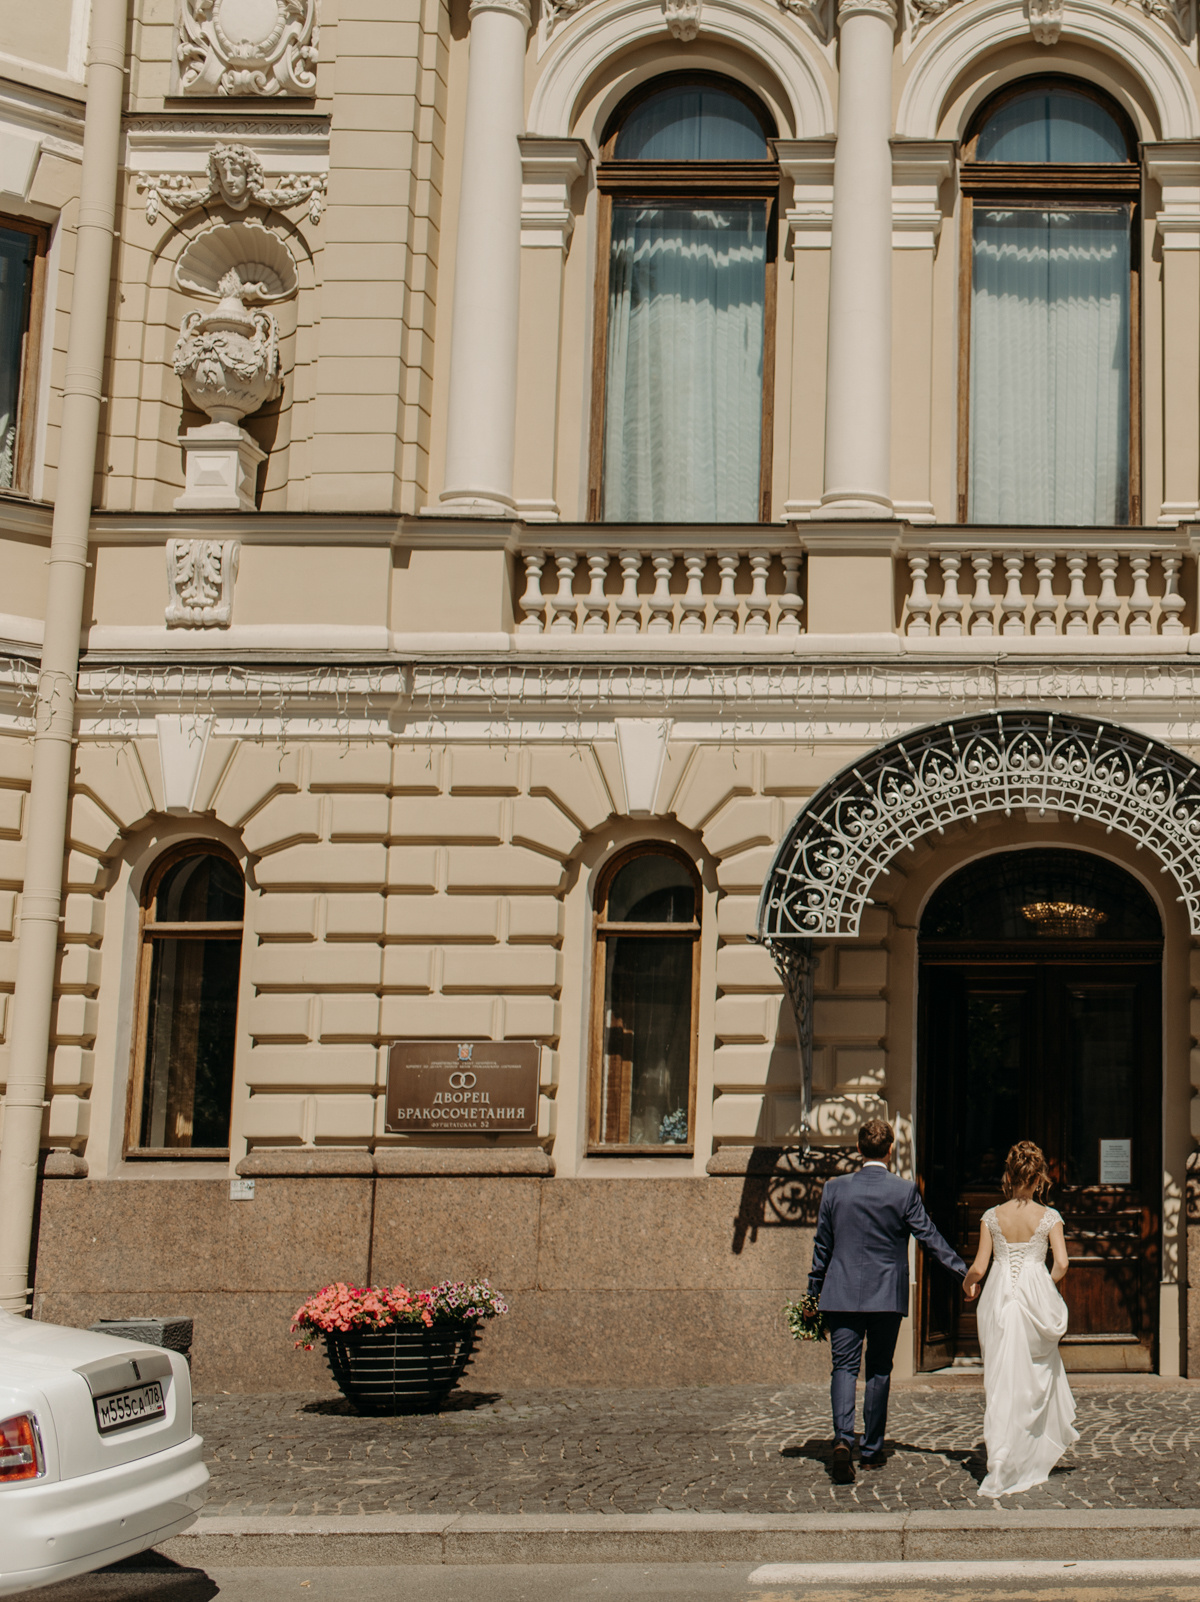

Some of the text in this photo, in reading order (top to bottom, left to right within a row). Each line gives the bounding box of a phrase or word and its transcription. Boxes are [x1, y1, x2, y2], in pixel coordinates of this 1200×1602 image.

[433, 1092, 490, 1105] ДВОРЕЦ
[397, 1108, 525, 1119] БРАКОСОЧЕТАНИЯ
[145, 1387, 160, 1405] 178
